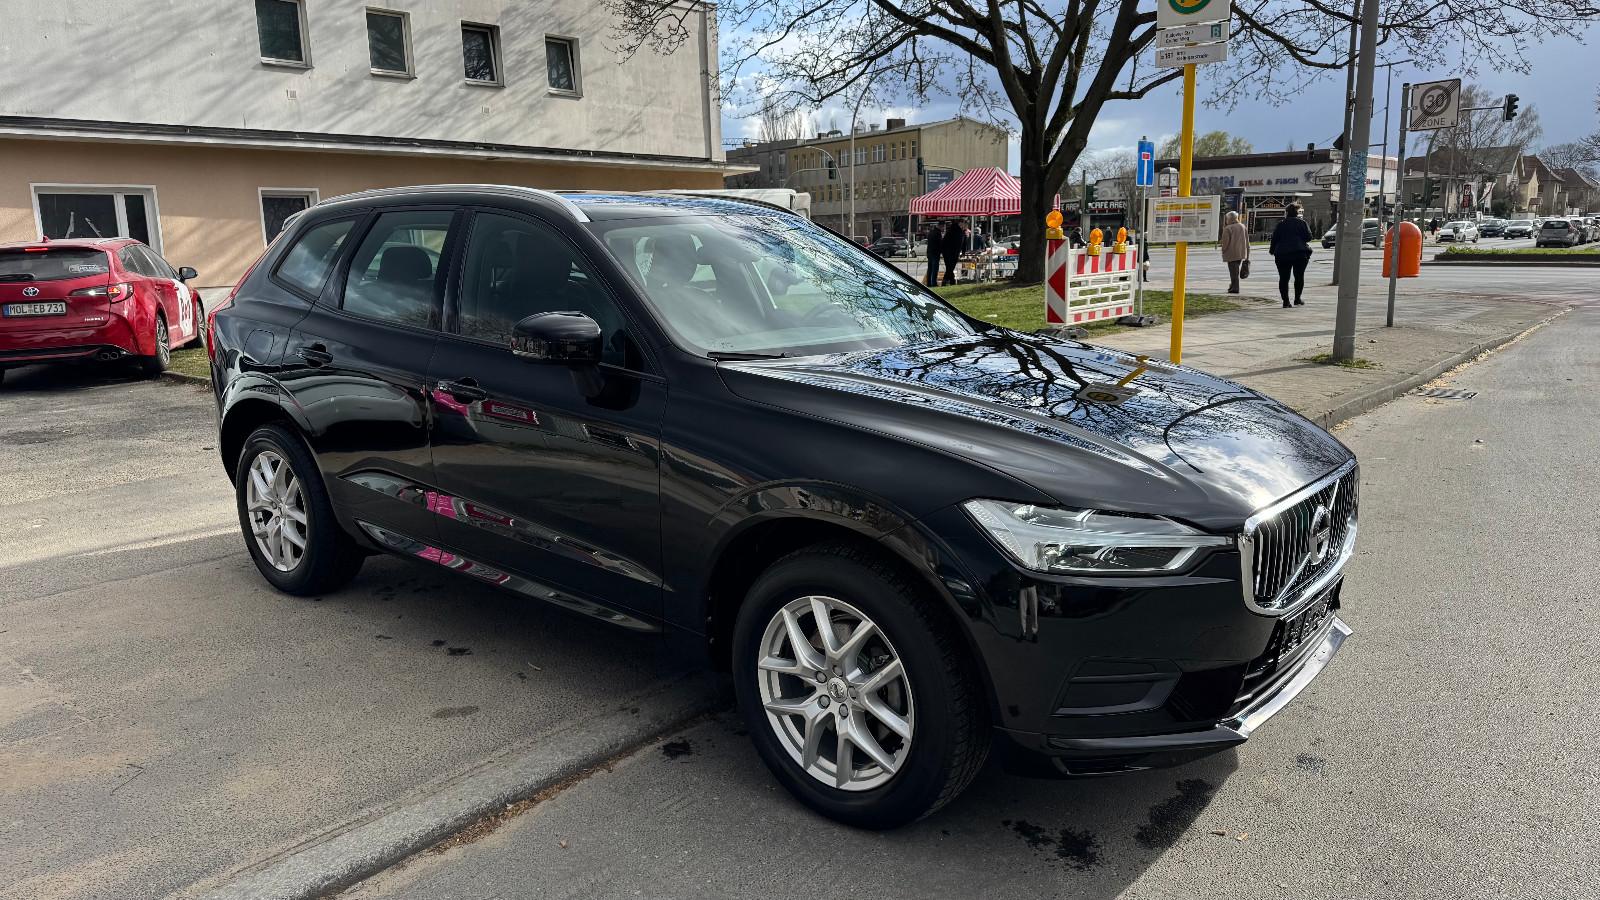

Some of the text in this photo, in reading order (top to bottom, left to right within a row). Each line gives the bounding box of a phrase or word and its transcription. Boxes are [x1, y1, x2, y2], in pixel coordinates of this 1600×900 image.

[1427, 93, 1446, 108] 30
[1422, 118, 1446, 127] ZONE
[1192, 176, 1234, 192] ARIN
[1239, 179, 1264, 187] STEAK
[1275, 177, 1299, 185] FISCH
[9, 303, 65, 314] MOL EB 731
